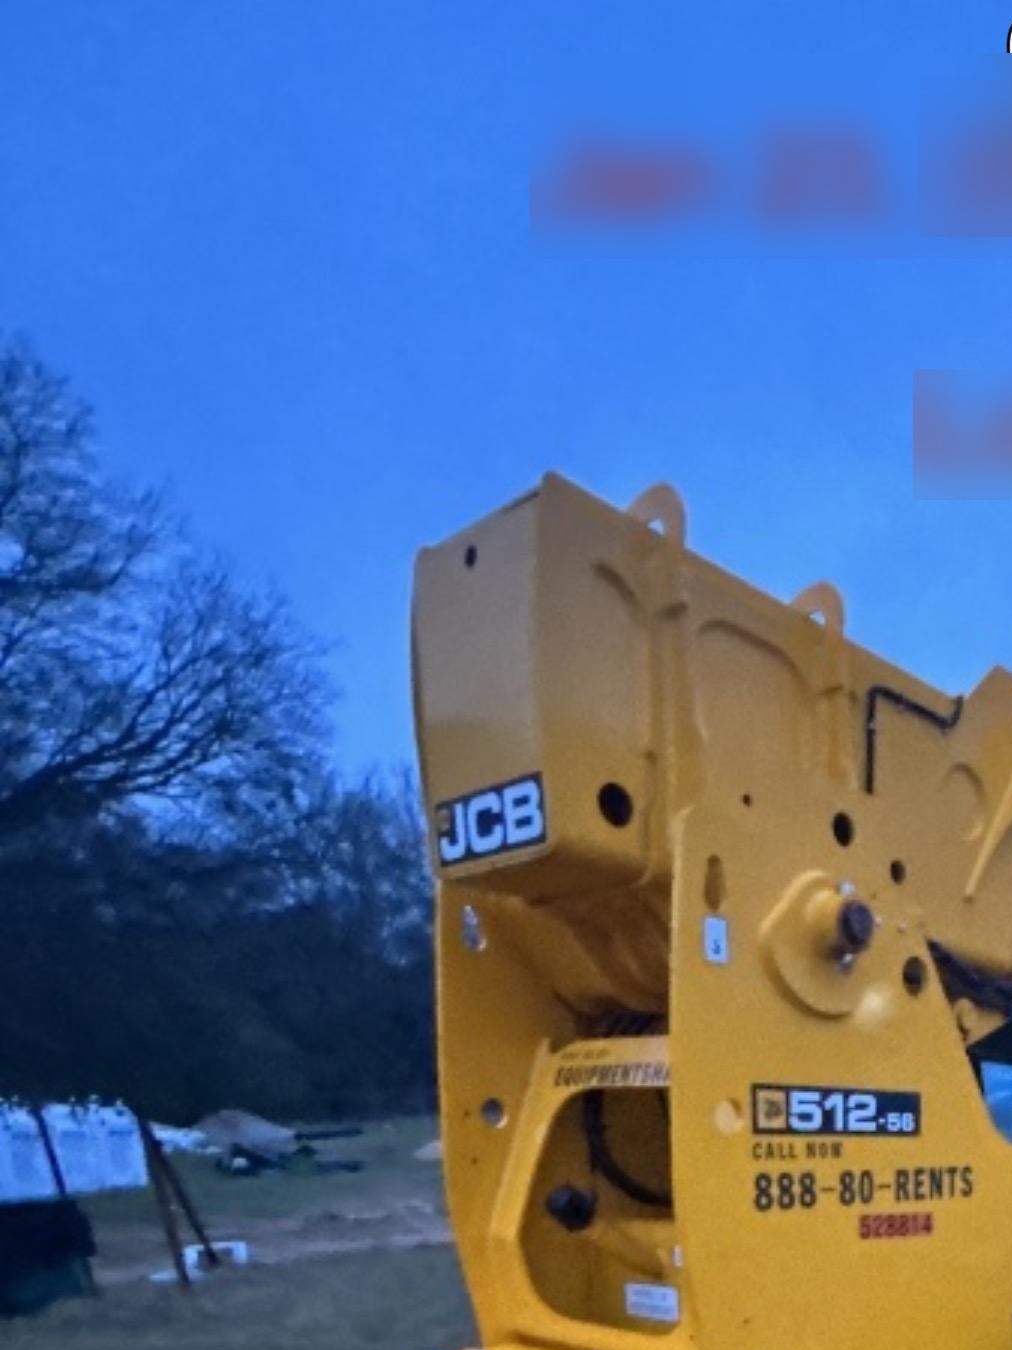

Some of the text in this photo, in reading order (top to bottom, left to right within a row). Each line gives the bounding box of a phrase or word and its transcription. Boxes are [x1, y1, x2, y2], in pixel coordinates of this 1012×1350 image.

[439, 778, 544, 862] JCB
[752, 1142, 843, 1160] CALL NOW
[754, 1165, 974, 1212] 888-80-RENTS
